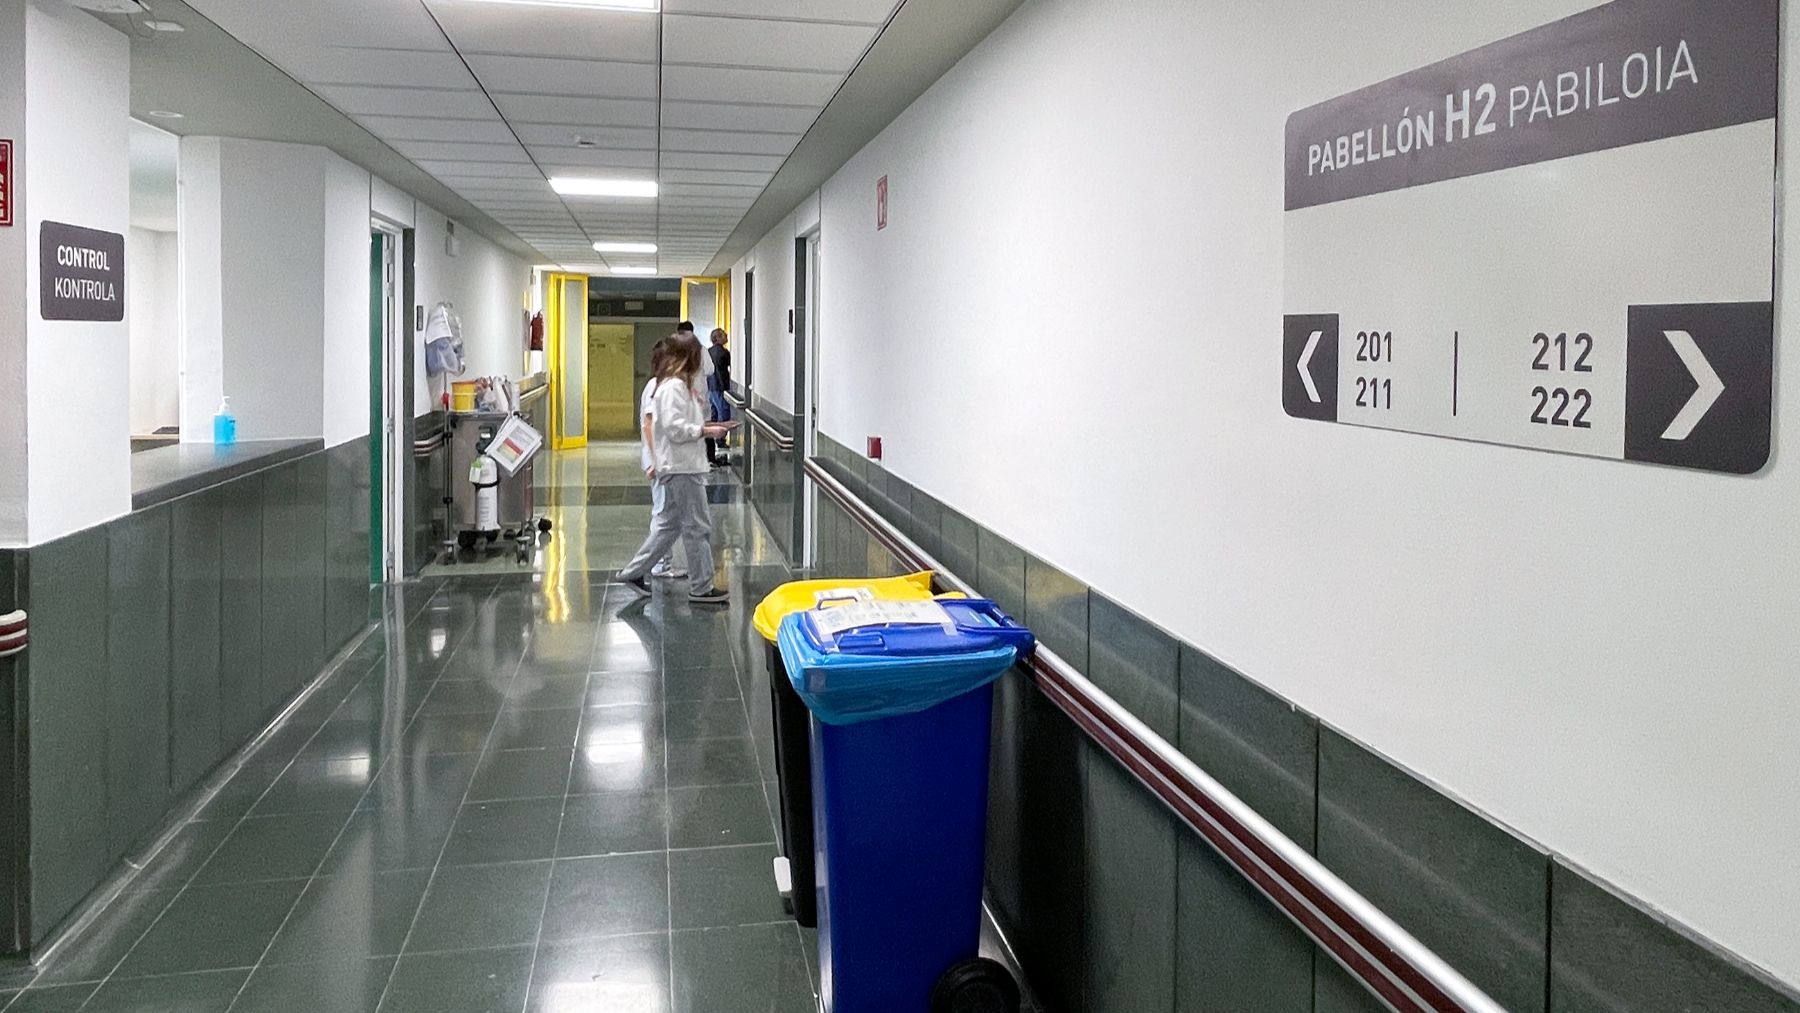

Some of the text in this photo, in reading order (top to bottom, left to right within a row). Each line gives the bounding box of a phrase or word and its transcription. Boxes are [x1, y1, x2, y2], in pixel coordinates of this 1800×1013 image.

[1308, 39, 1699, 177] PABELLÓN H2 PABILOIA
[57, 244, 111, 271] CONTROL
[54, 277, 116, 301] KONTROLA
[1355, 331, 1392, 363] 201
[1531, 332, 1594, 373] 212
[1355, 376, 1391, 410] 211
[1530, 385, 1592, 429] 222
